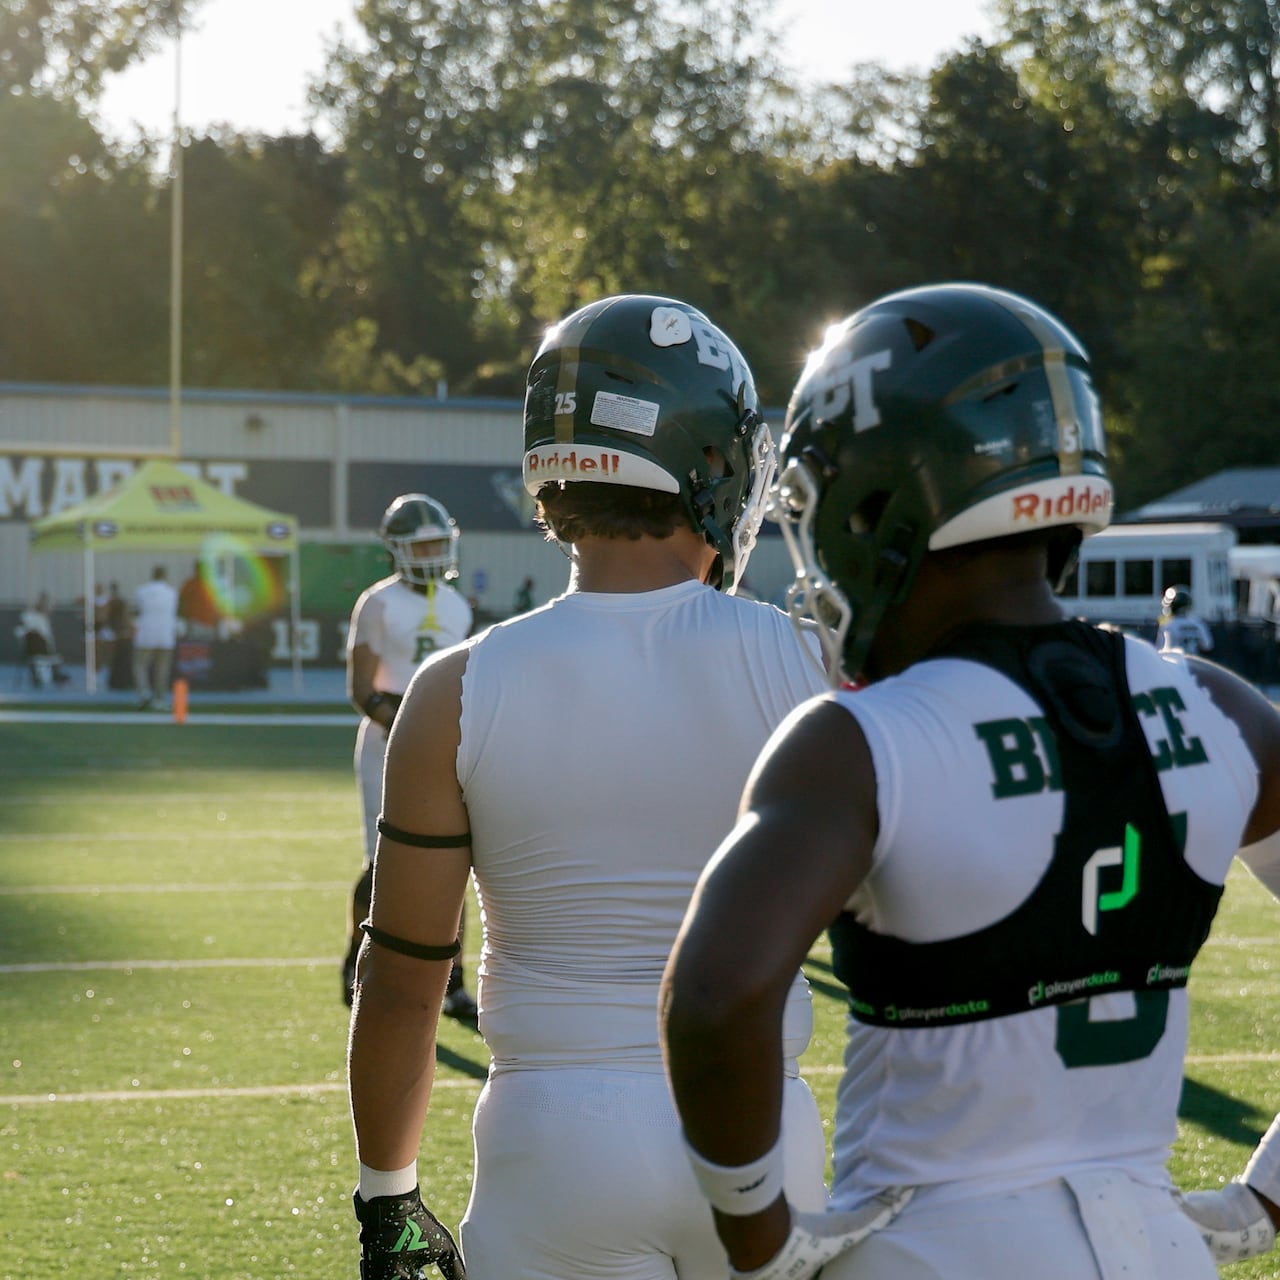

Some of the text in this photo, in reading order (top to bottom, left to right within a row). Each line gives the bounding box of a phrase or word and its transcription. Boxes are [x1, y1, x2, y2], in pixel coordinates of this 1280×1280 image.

[554, 391, 577, 416] 25
[528, 450, 620, 476] Riddell
[1044, 970, 1119, 999] playerdata
[897, 1000, 990, 1021] playerdata
